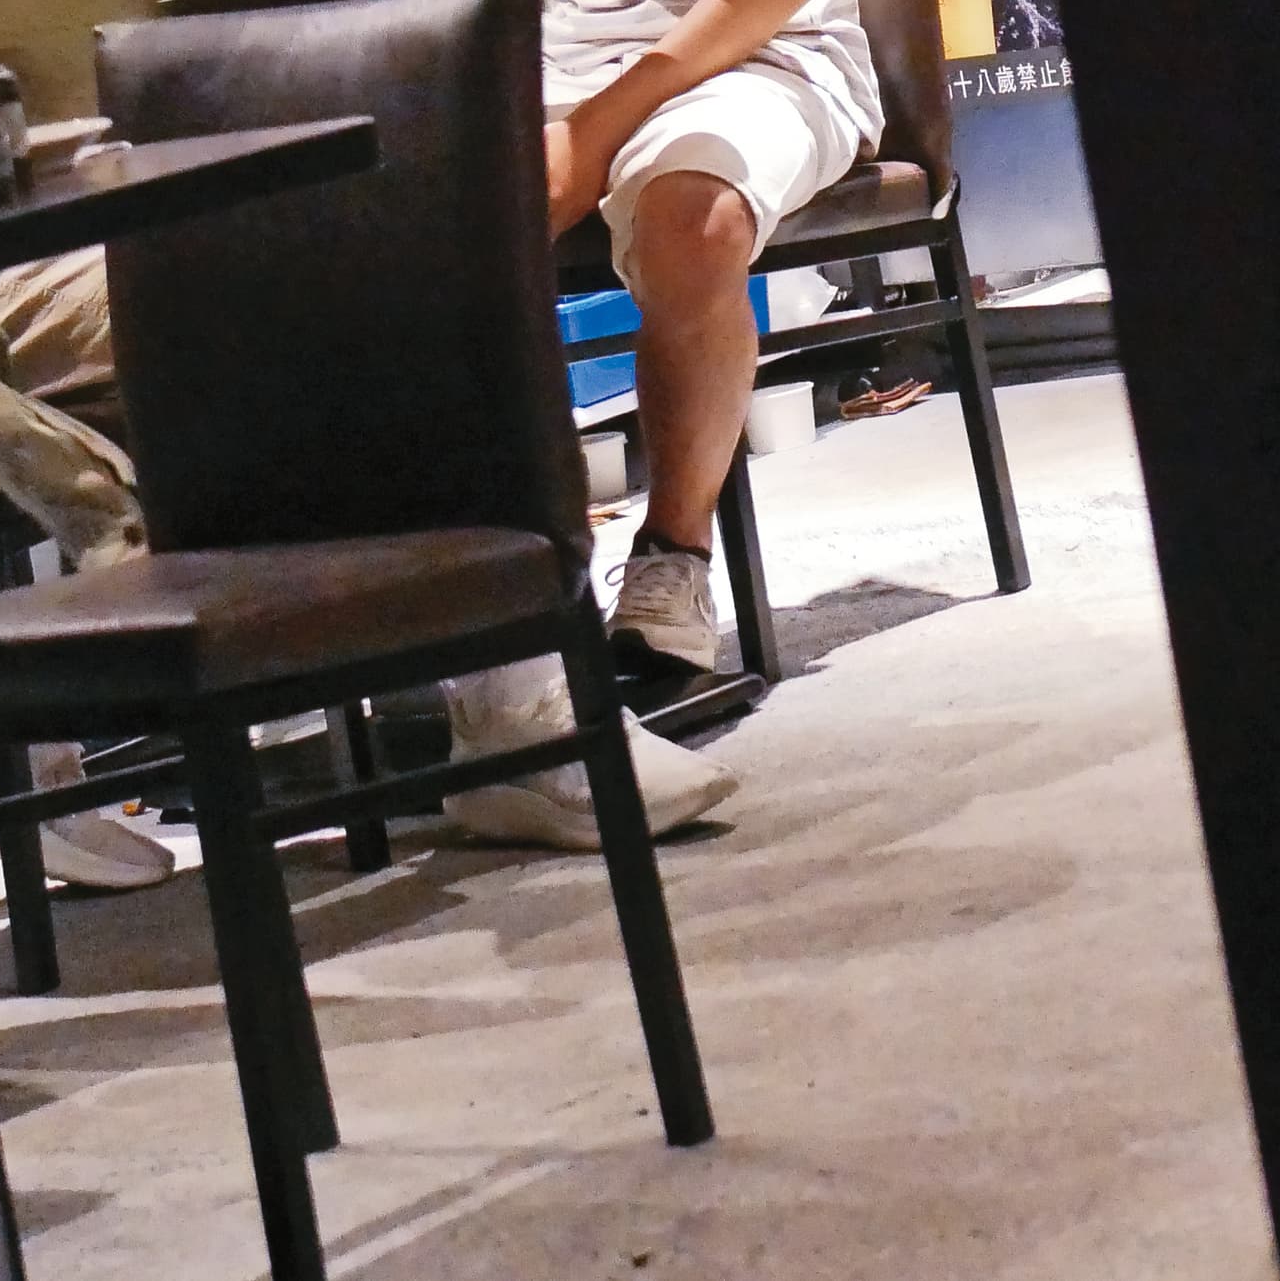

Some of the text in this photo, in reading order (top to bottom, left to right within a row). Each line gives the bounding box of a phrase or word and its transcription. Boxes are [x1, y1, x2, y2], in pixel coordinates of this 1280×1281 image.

[947, 56, 1075, 100] 十八歲禁止
